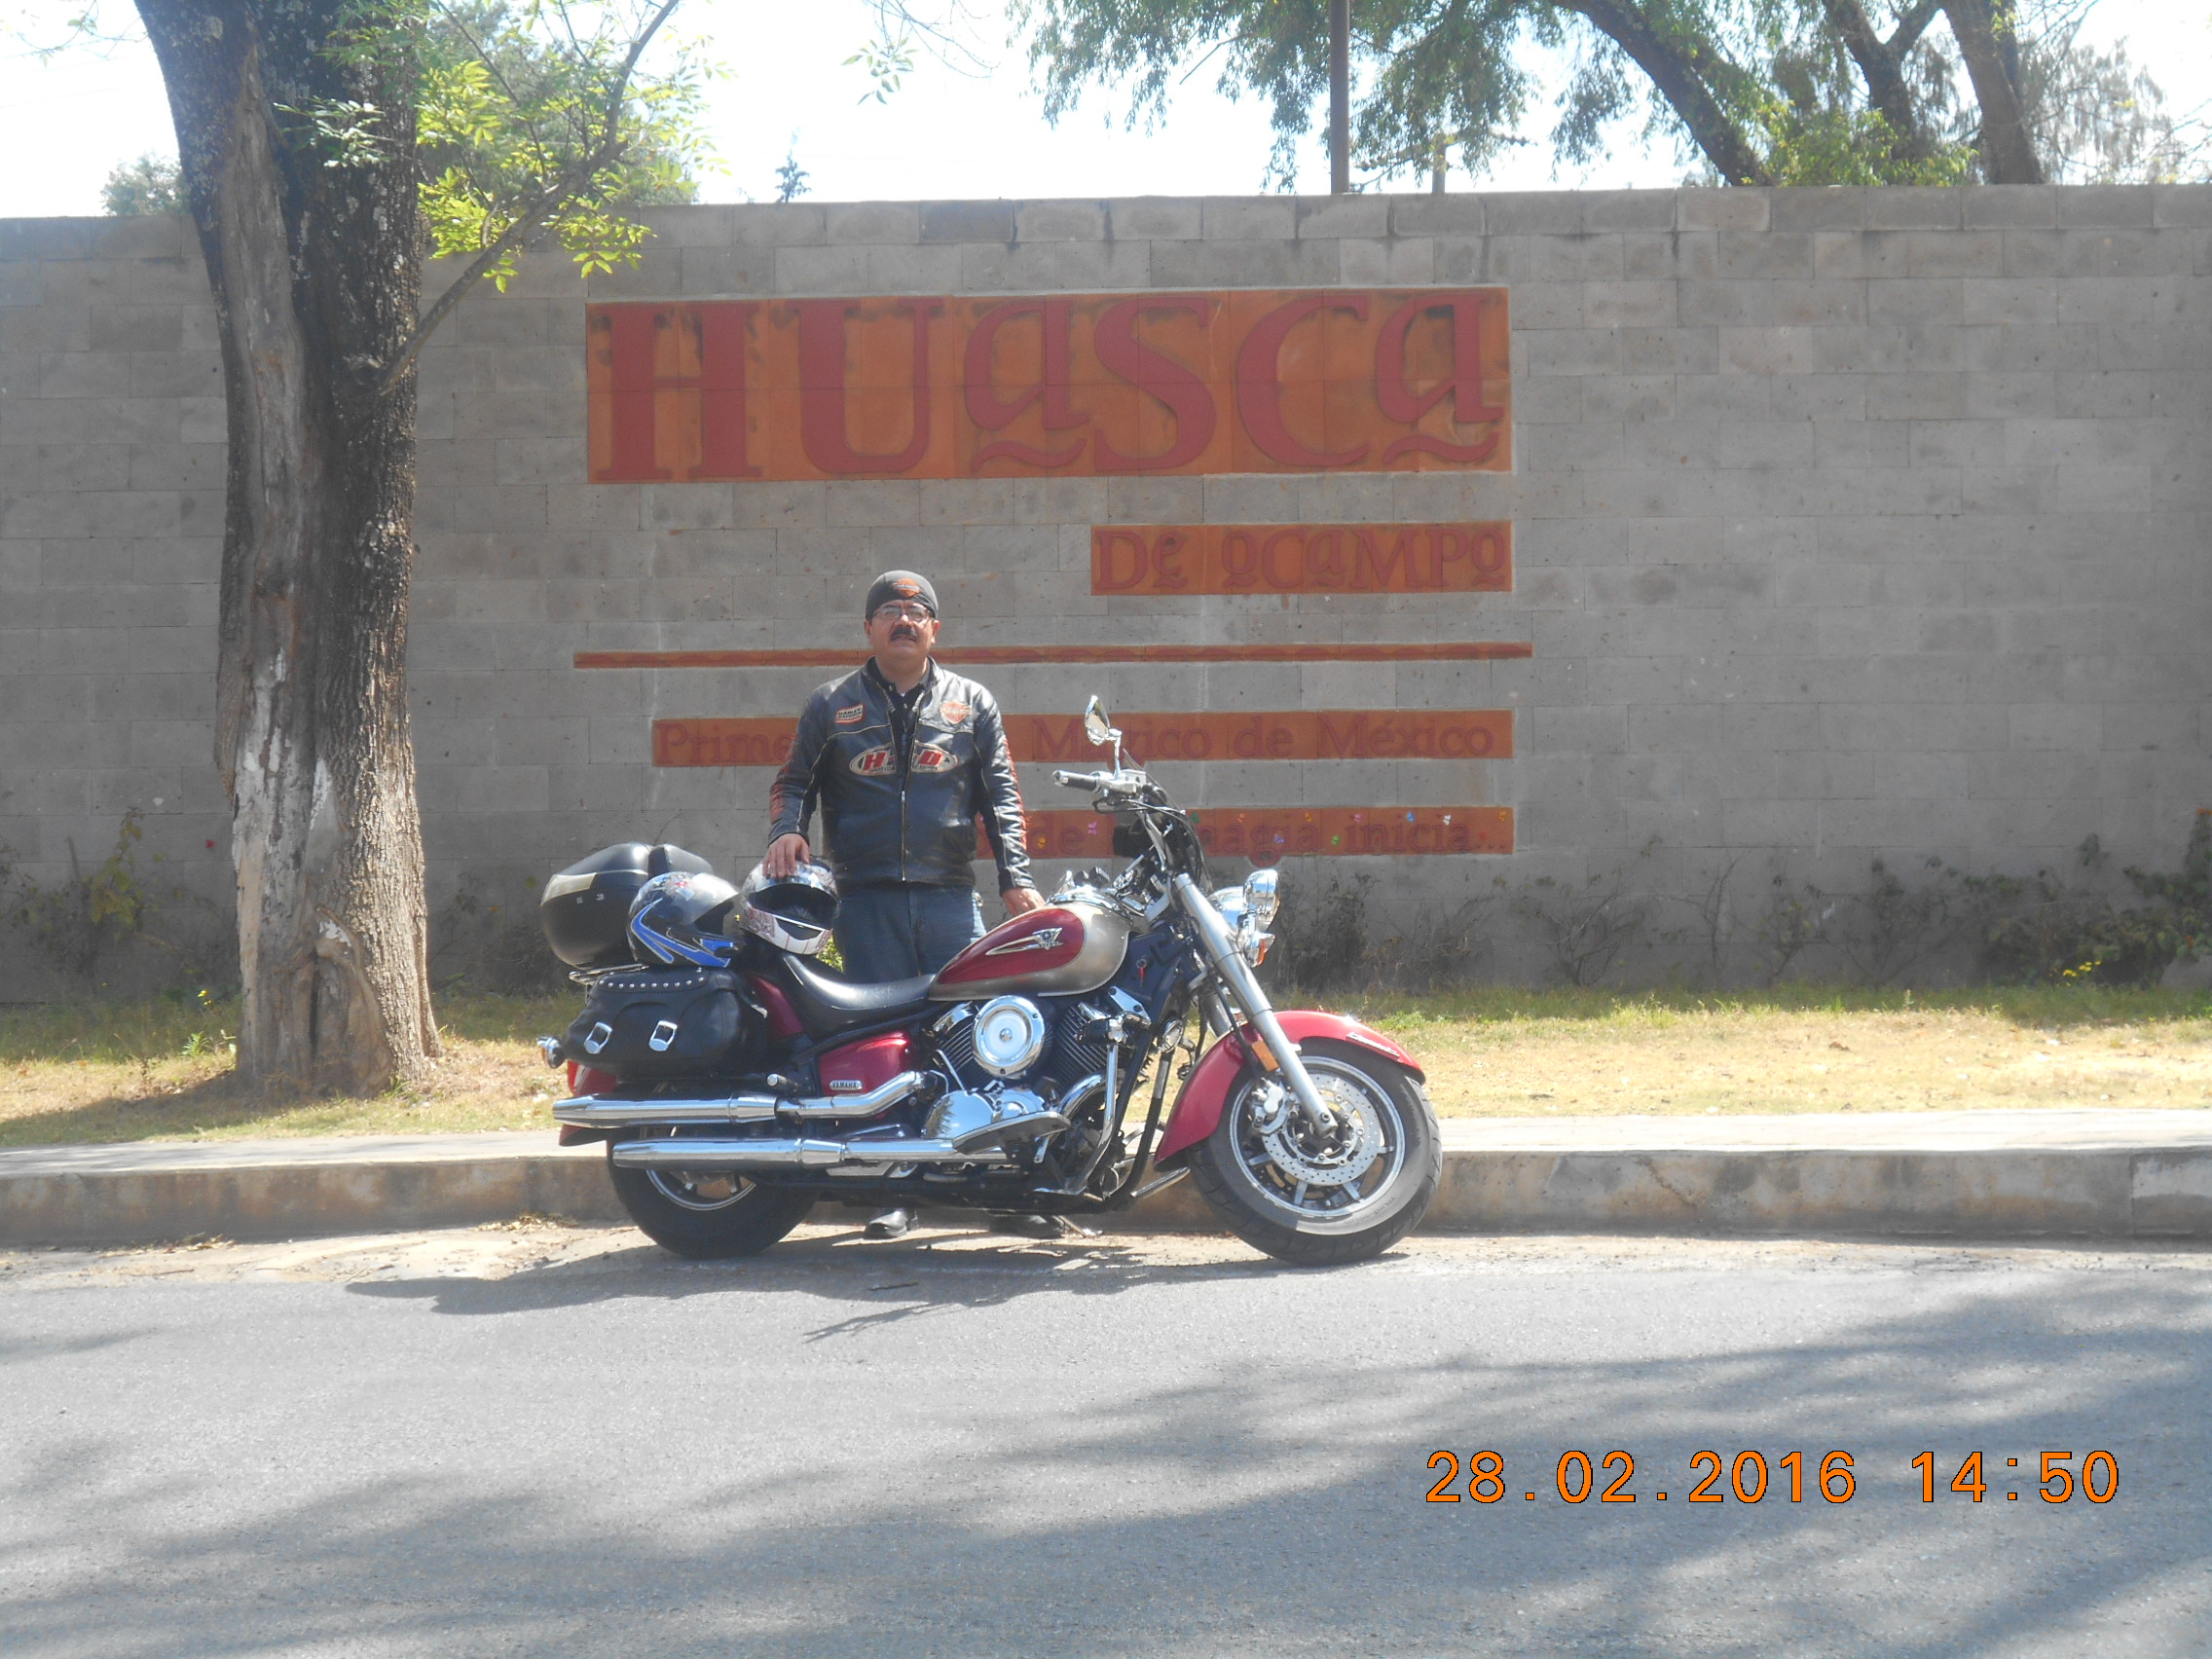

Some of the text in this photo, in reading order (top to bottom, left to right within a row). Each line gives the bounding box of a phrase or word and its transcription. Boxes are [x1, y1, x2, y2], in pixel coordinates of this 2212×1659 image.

[656, 722, 794, 763] Prime
[1233, 715, 1293, 757] de
[1318, 714, 1493, 756] México
[831, 1081, 857, 1089] YAMAHA
